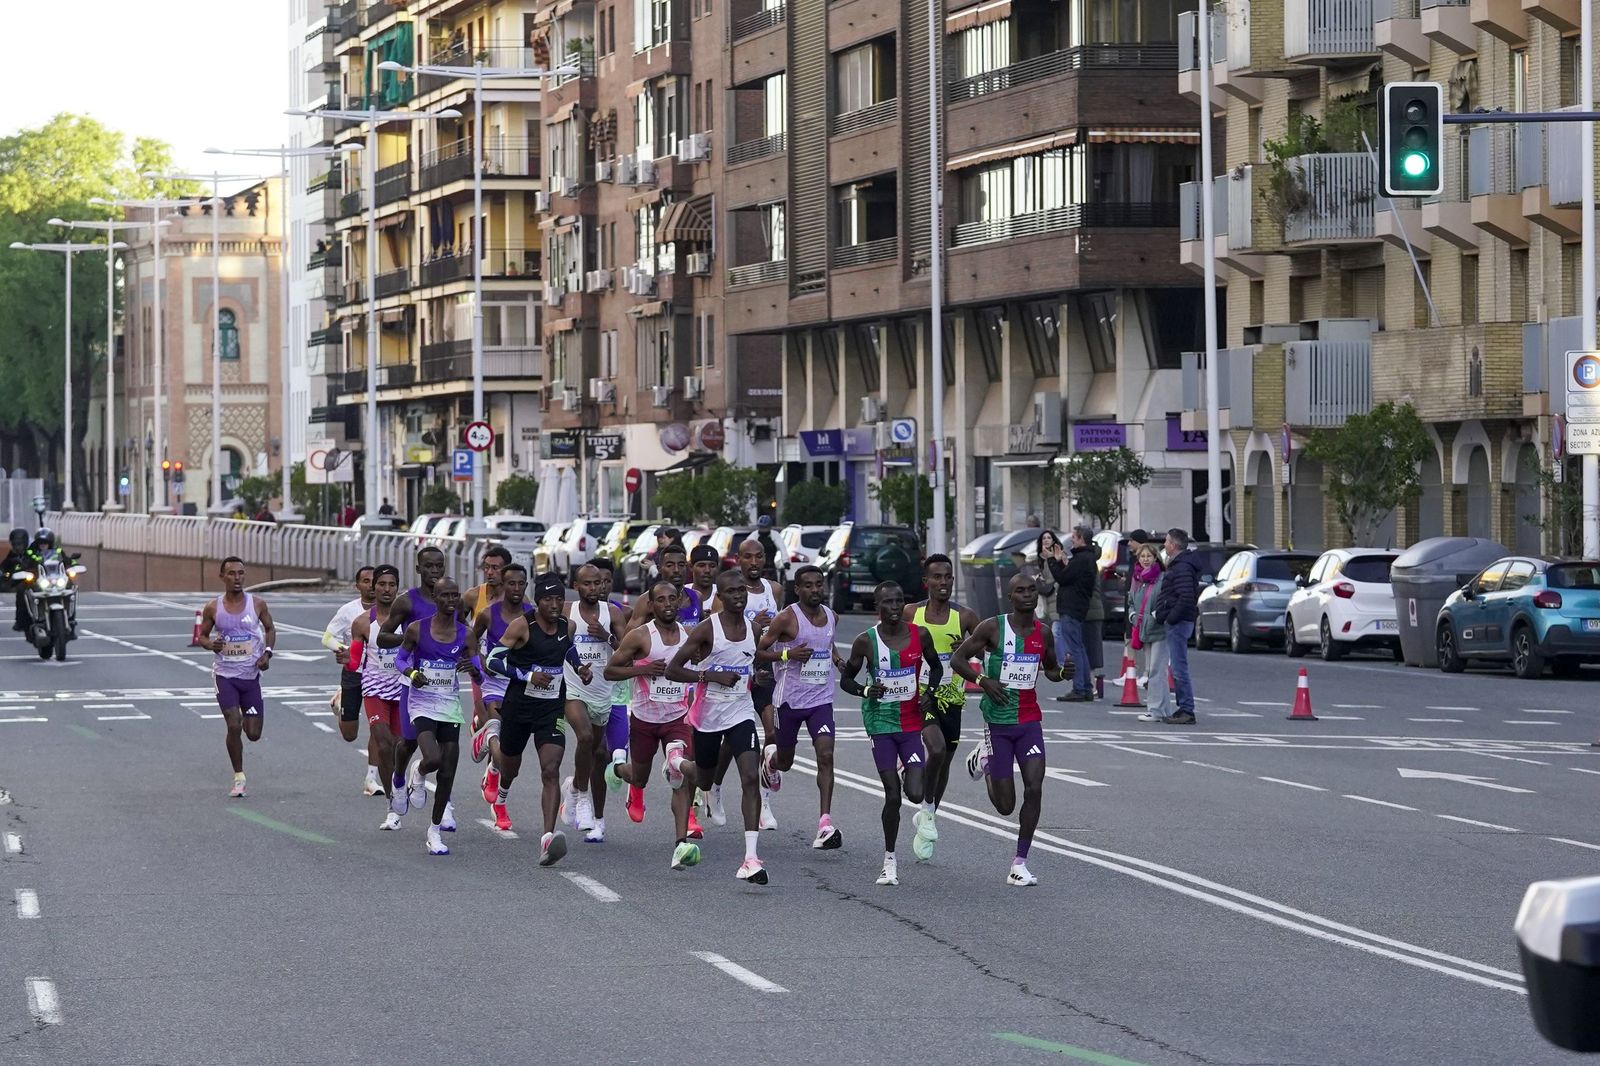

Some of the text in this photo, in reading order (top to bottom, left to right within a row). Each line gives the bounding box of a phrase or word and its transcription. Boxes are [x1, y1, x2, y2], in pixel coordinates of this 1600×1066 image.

[586, 437, 620, 446] TINTE
[1080, 436, 1121, 444] PIERCING
[1570, 441, 1591, 449] SECTOR
[455, 452, 469, 470] P
[580, 652, 601, 660] ASRAR
[888, 668, 911, 677] ZURICH
[1008, 672, 1031, 681] PACER
[656, 686, 681, 695] DEGEFA
[885, 686, 909, 695] PACER
